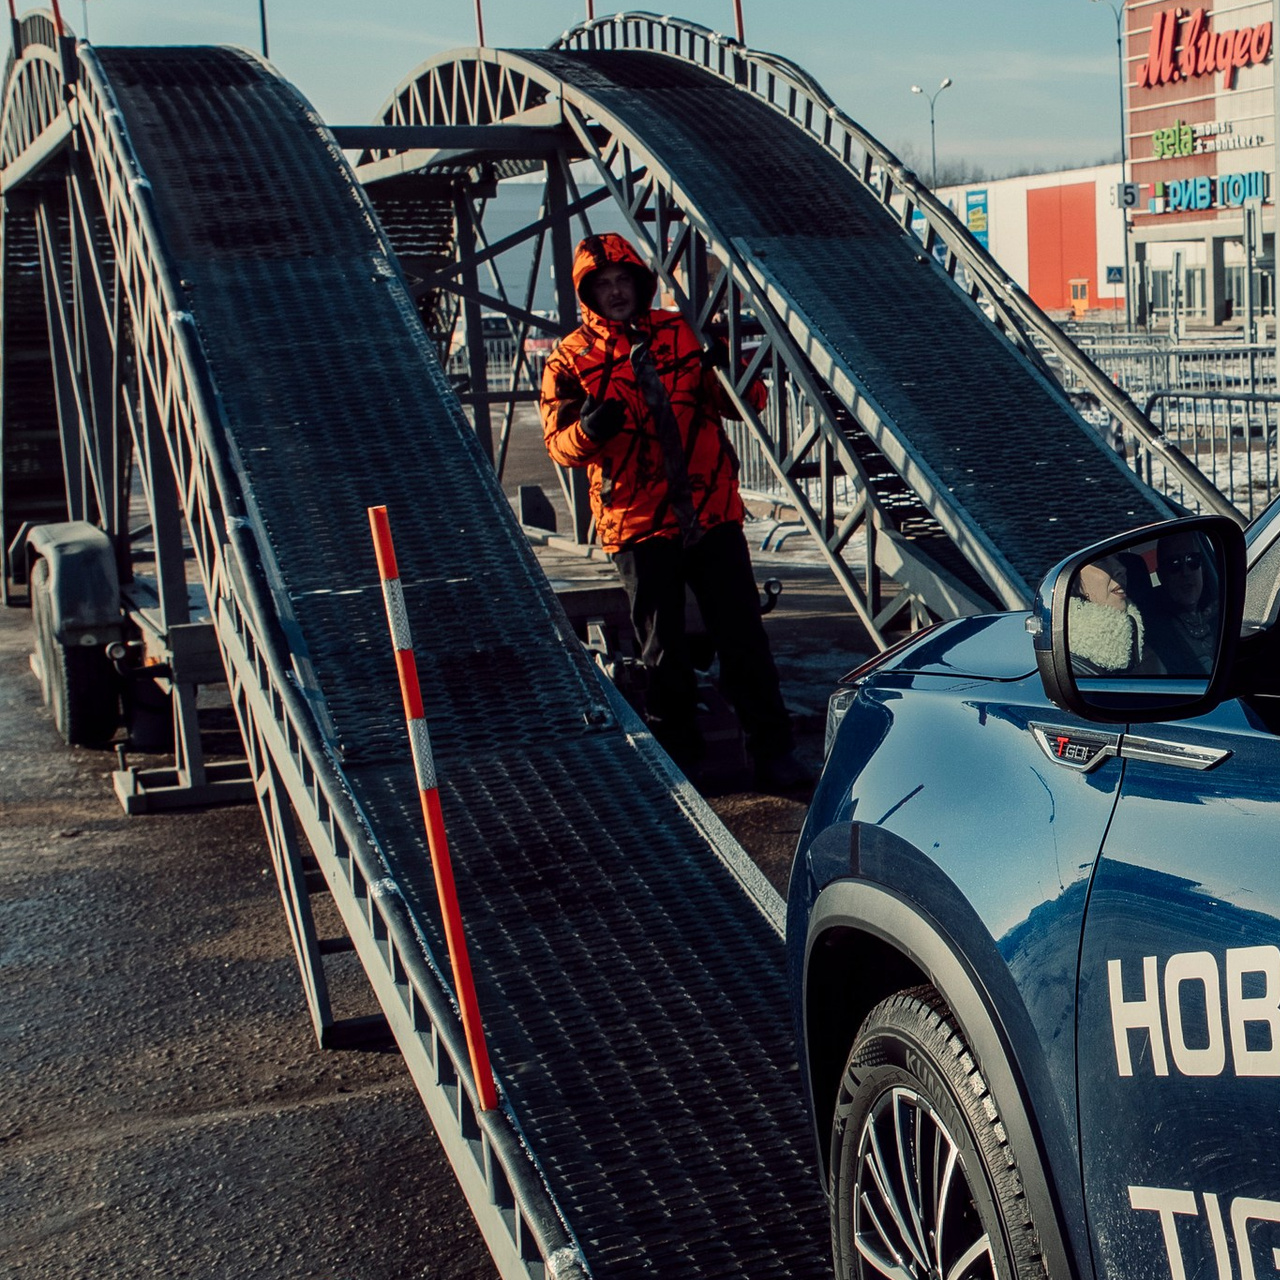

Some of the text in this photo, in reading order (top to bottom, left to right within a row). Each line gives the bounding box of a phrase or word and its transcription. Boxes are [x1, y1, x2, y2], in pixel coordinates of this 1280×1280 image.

[1137, 8, 1273, 89] М.видео
[1152, 119, 1193, 158] sela
[1123, 185, 1136, 206] 5
[1168, 171, 1265, 211] РИВ ГОШ
